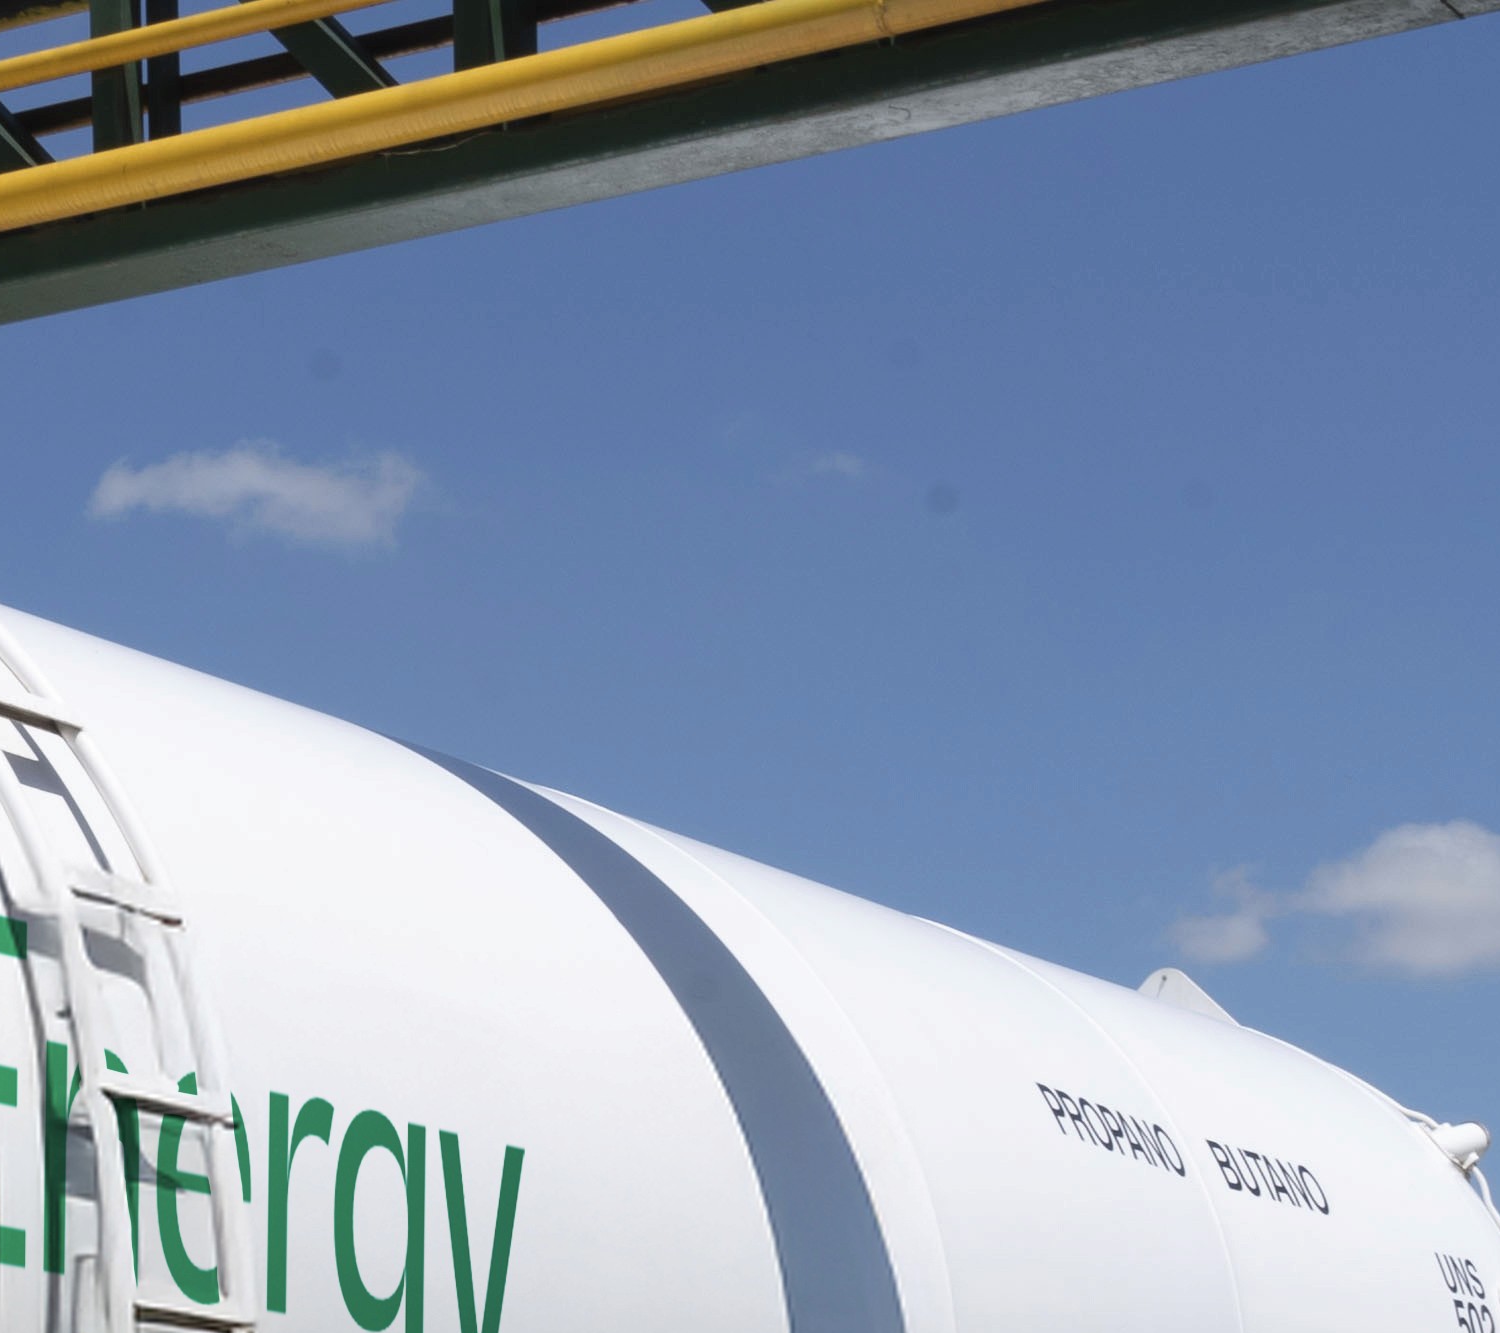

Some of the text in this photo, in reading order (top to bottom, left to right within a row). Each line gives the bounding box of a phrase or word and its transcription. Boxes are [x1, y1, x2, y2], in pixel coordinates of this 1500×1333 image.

[1035, 1082, 1331, 1216] PROPANO BUTANO
[1434, 1252, 1486, 1300] UNS
